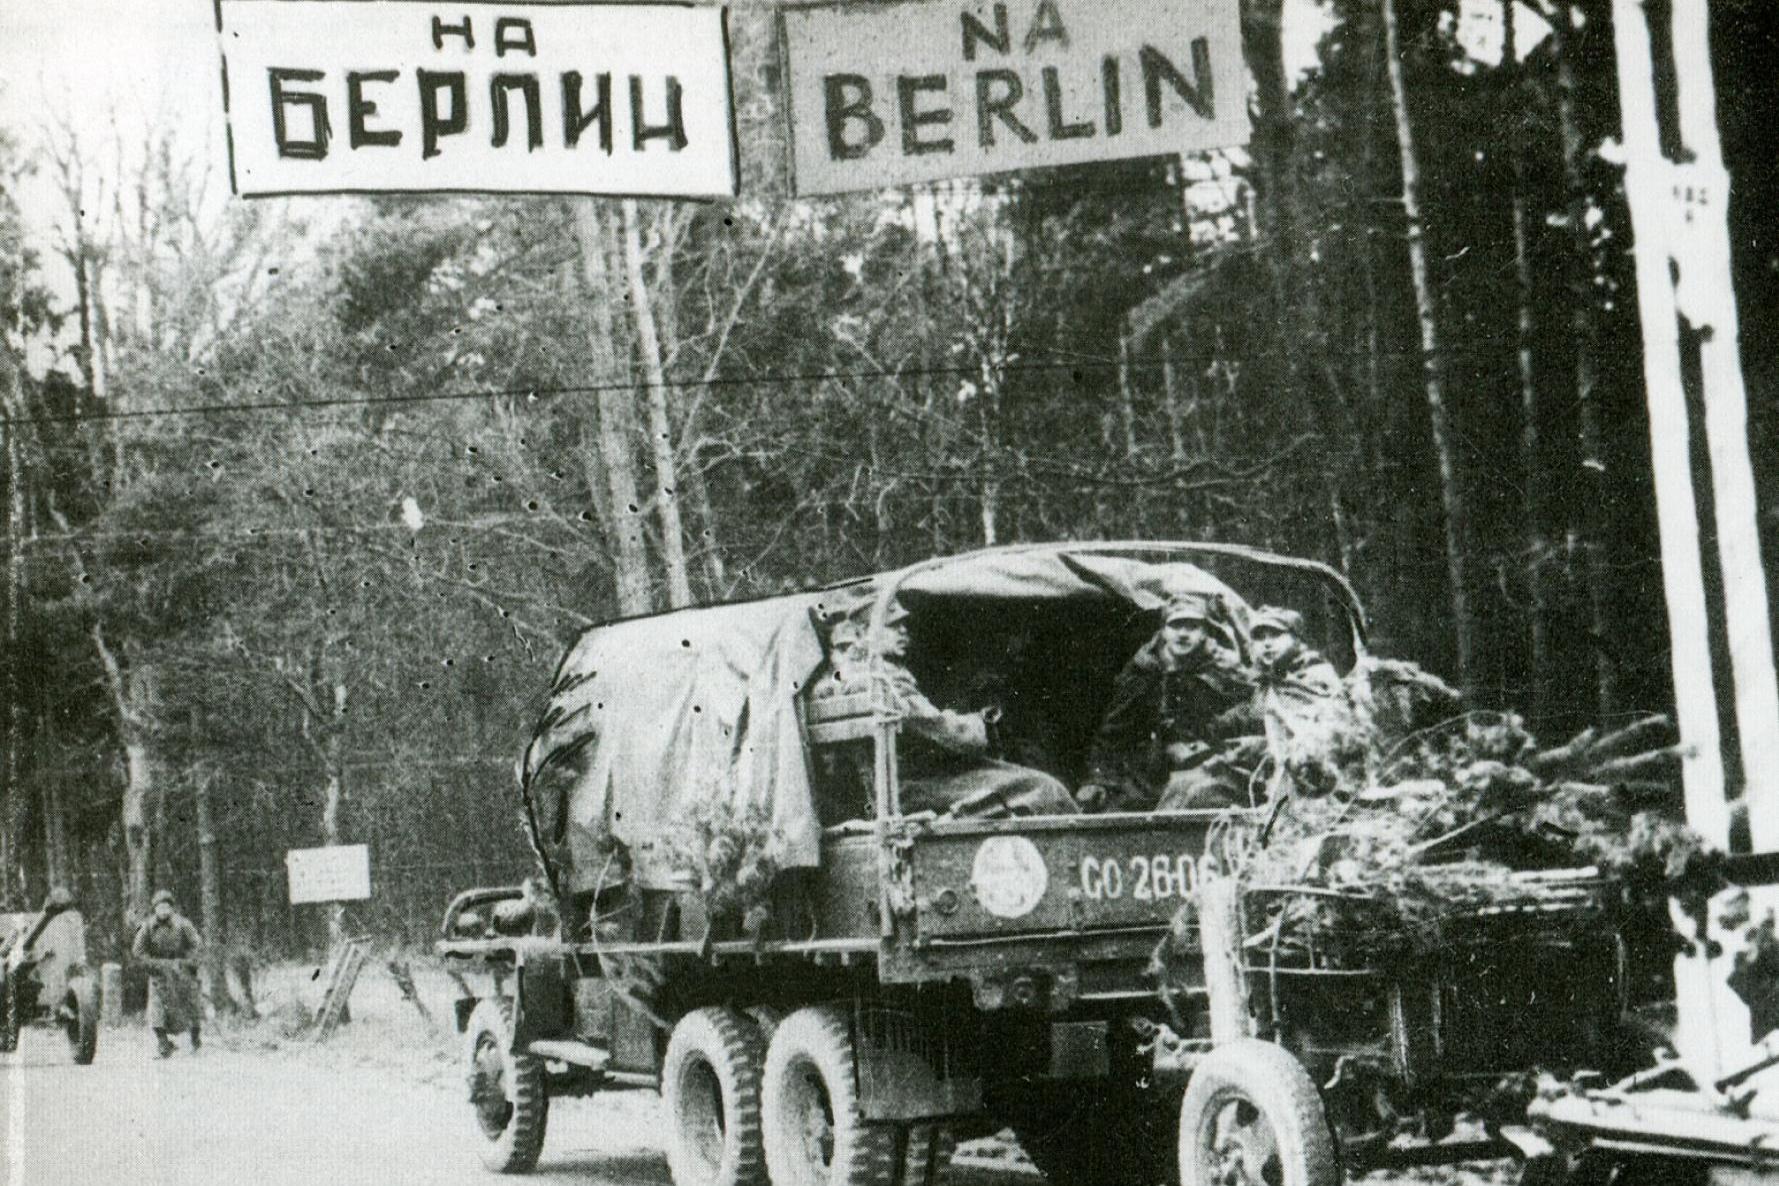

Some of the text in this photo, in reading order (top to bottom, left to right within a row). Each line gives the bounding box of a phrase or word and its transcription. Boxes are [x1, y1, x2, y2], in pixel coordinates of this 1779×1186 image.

[432, 15, 537, 57] НА
[960, 0, 1071, 62] NA
[267, 66, 689, 161] БЕРЛИН
[823, 35, 1216, 161] BERLIN
